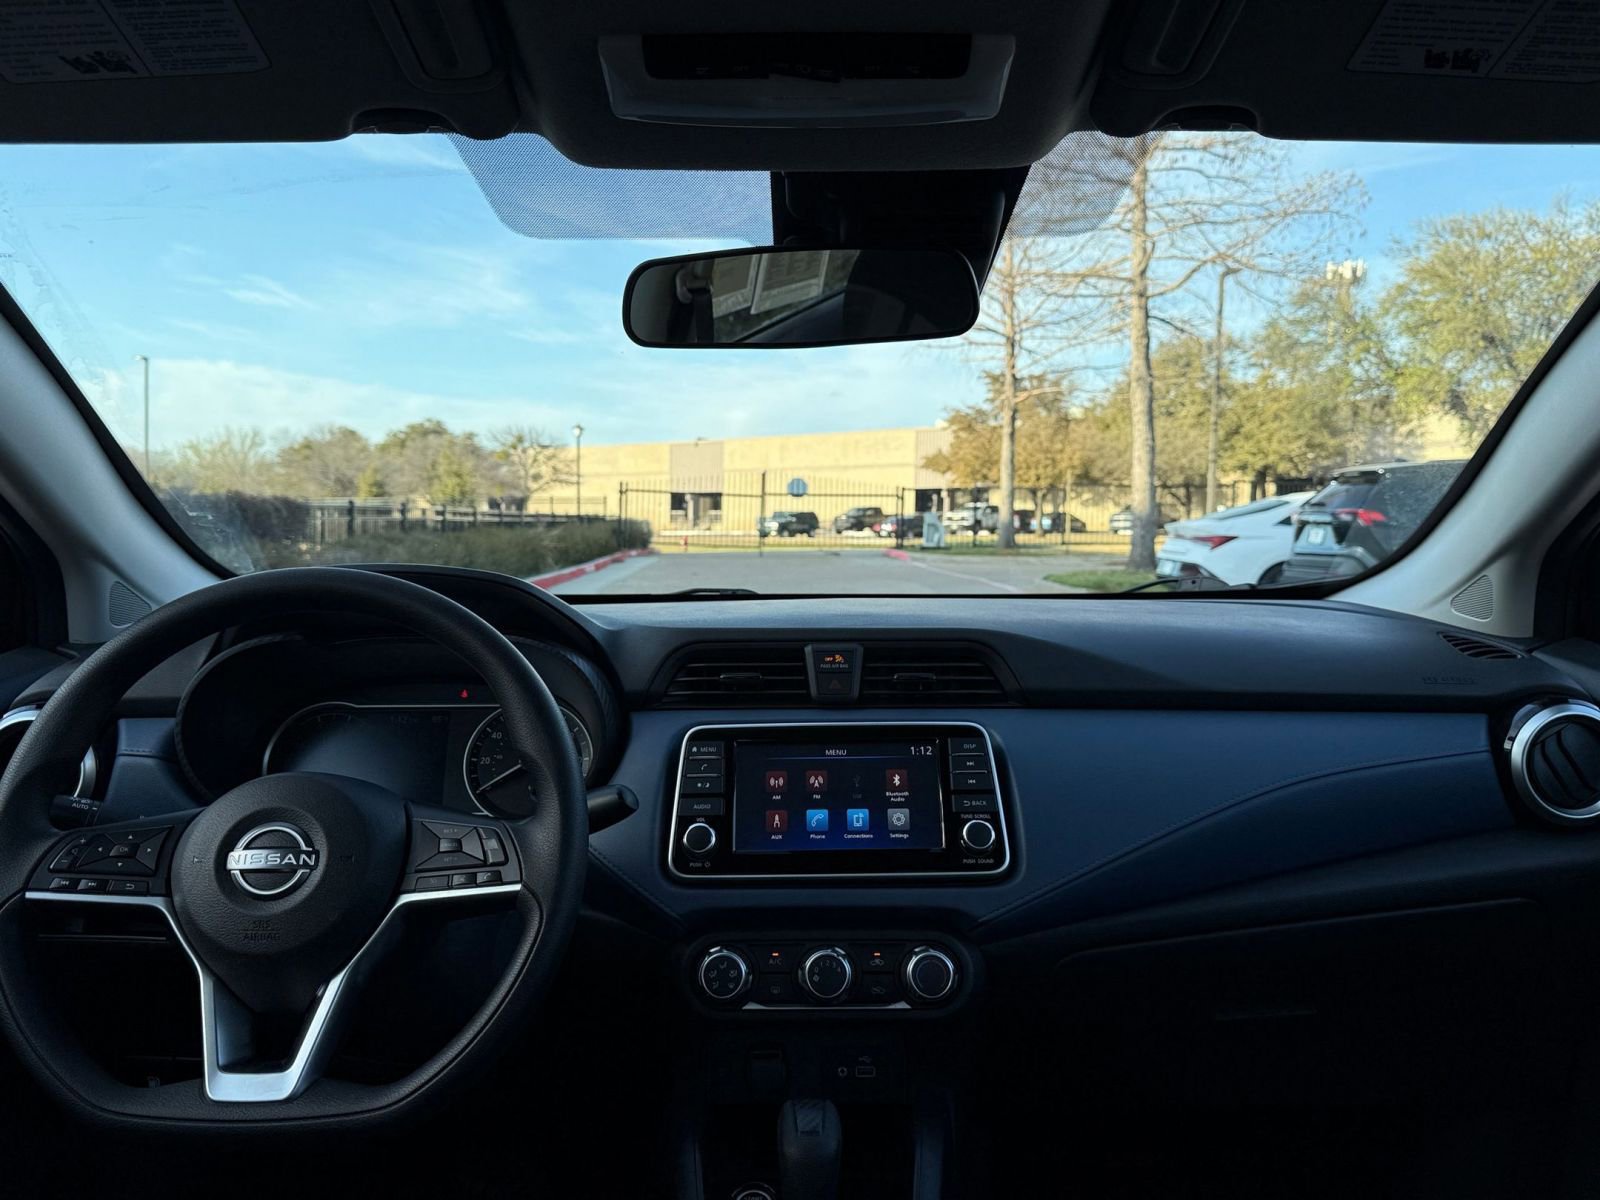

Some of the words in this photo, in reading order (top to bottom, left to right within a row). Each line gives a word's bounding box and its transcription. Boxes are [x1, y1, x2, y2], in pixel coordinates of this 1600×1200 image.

[491, 732, 503, 740] 40
[910, 746, 933, 756] 1:12
[480, 756, 490, 764] 20
[227, 851, 317, 866] NISSAN
